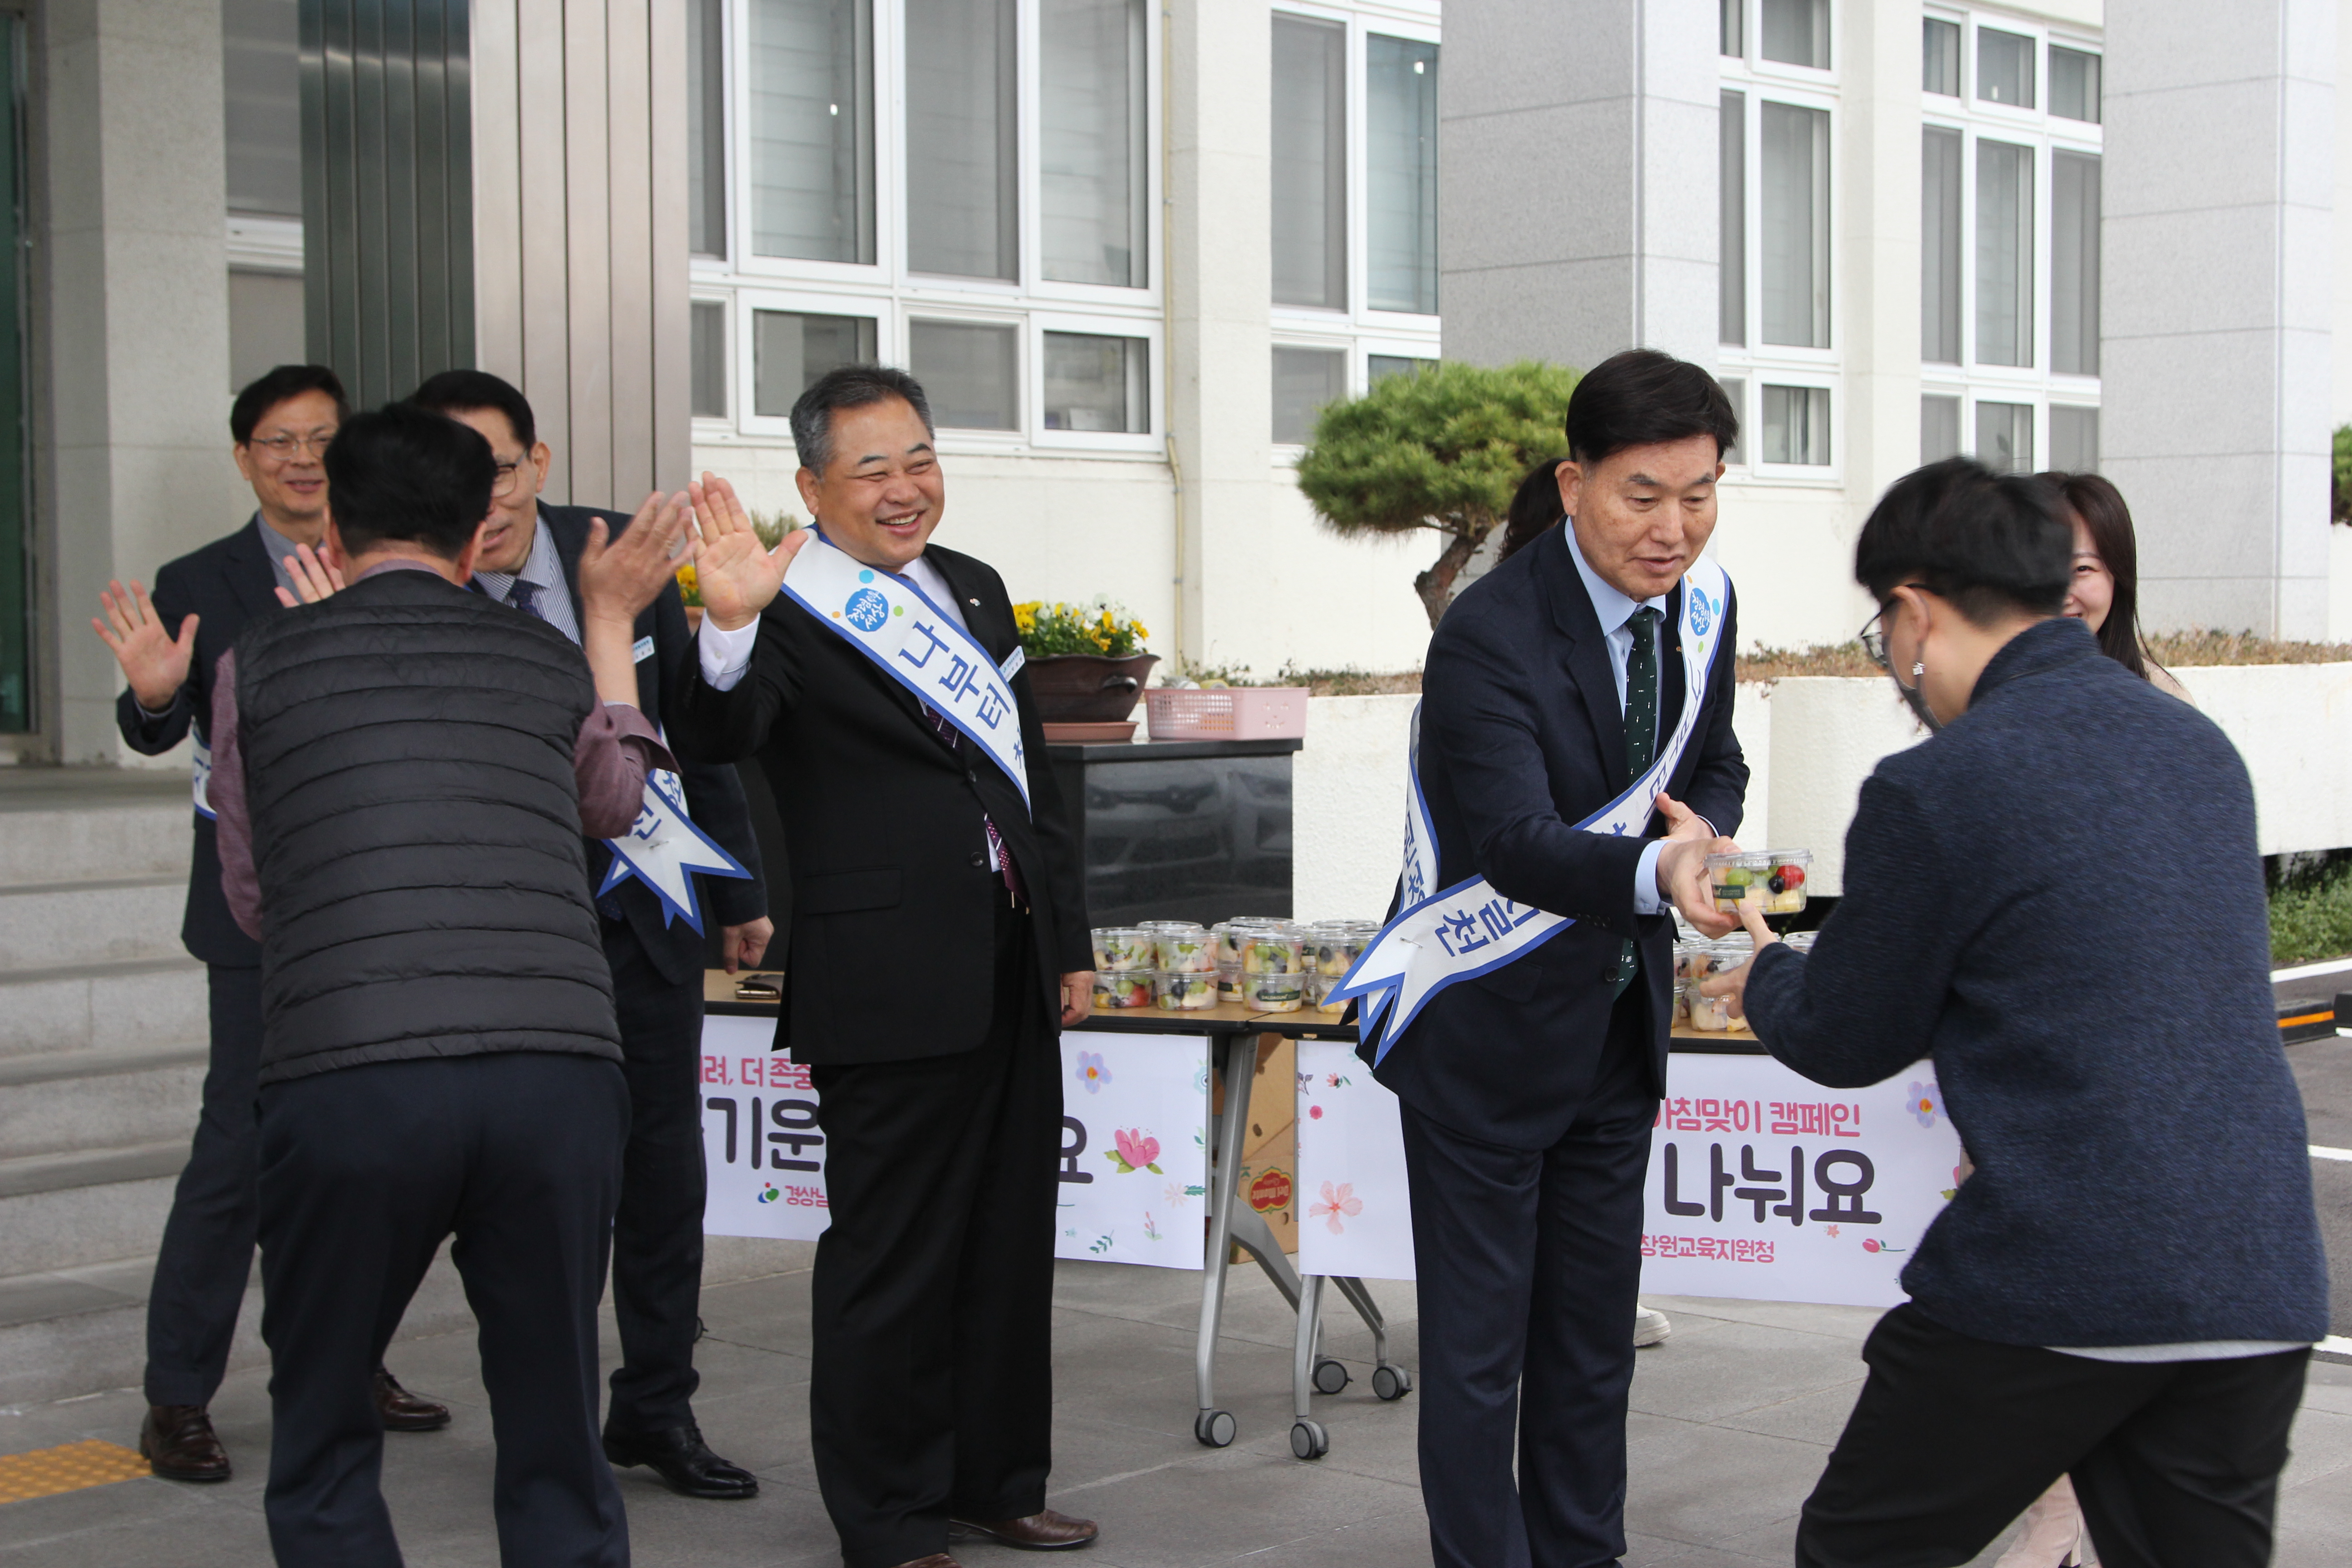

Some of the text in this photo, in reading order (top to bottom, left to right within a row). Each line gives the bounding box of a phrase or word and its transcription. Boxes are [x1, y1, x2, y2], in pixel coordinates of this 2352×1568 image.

[898, 621, 1010, 730] 나부터
[699, 1055, 734, 1086] 려,
[741, 1057, 763, 1088] 더
[706, 1096, 825, 1172] 기운
[1652, 1097, 1860, 1137] 아침맞이 캠페인
[1664, 1142, 1882, 1227] 나눠요
[1640, 1234, 1774, 1264] 창원교육지원청
